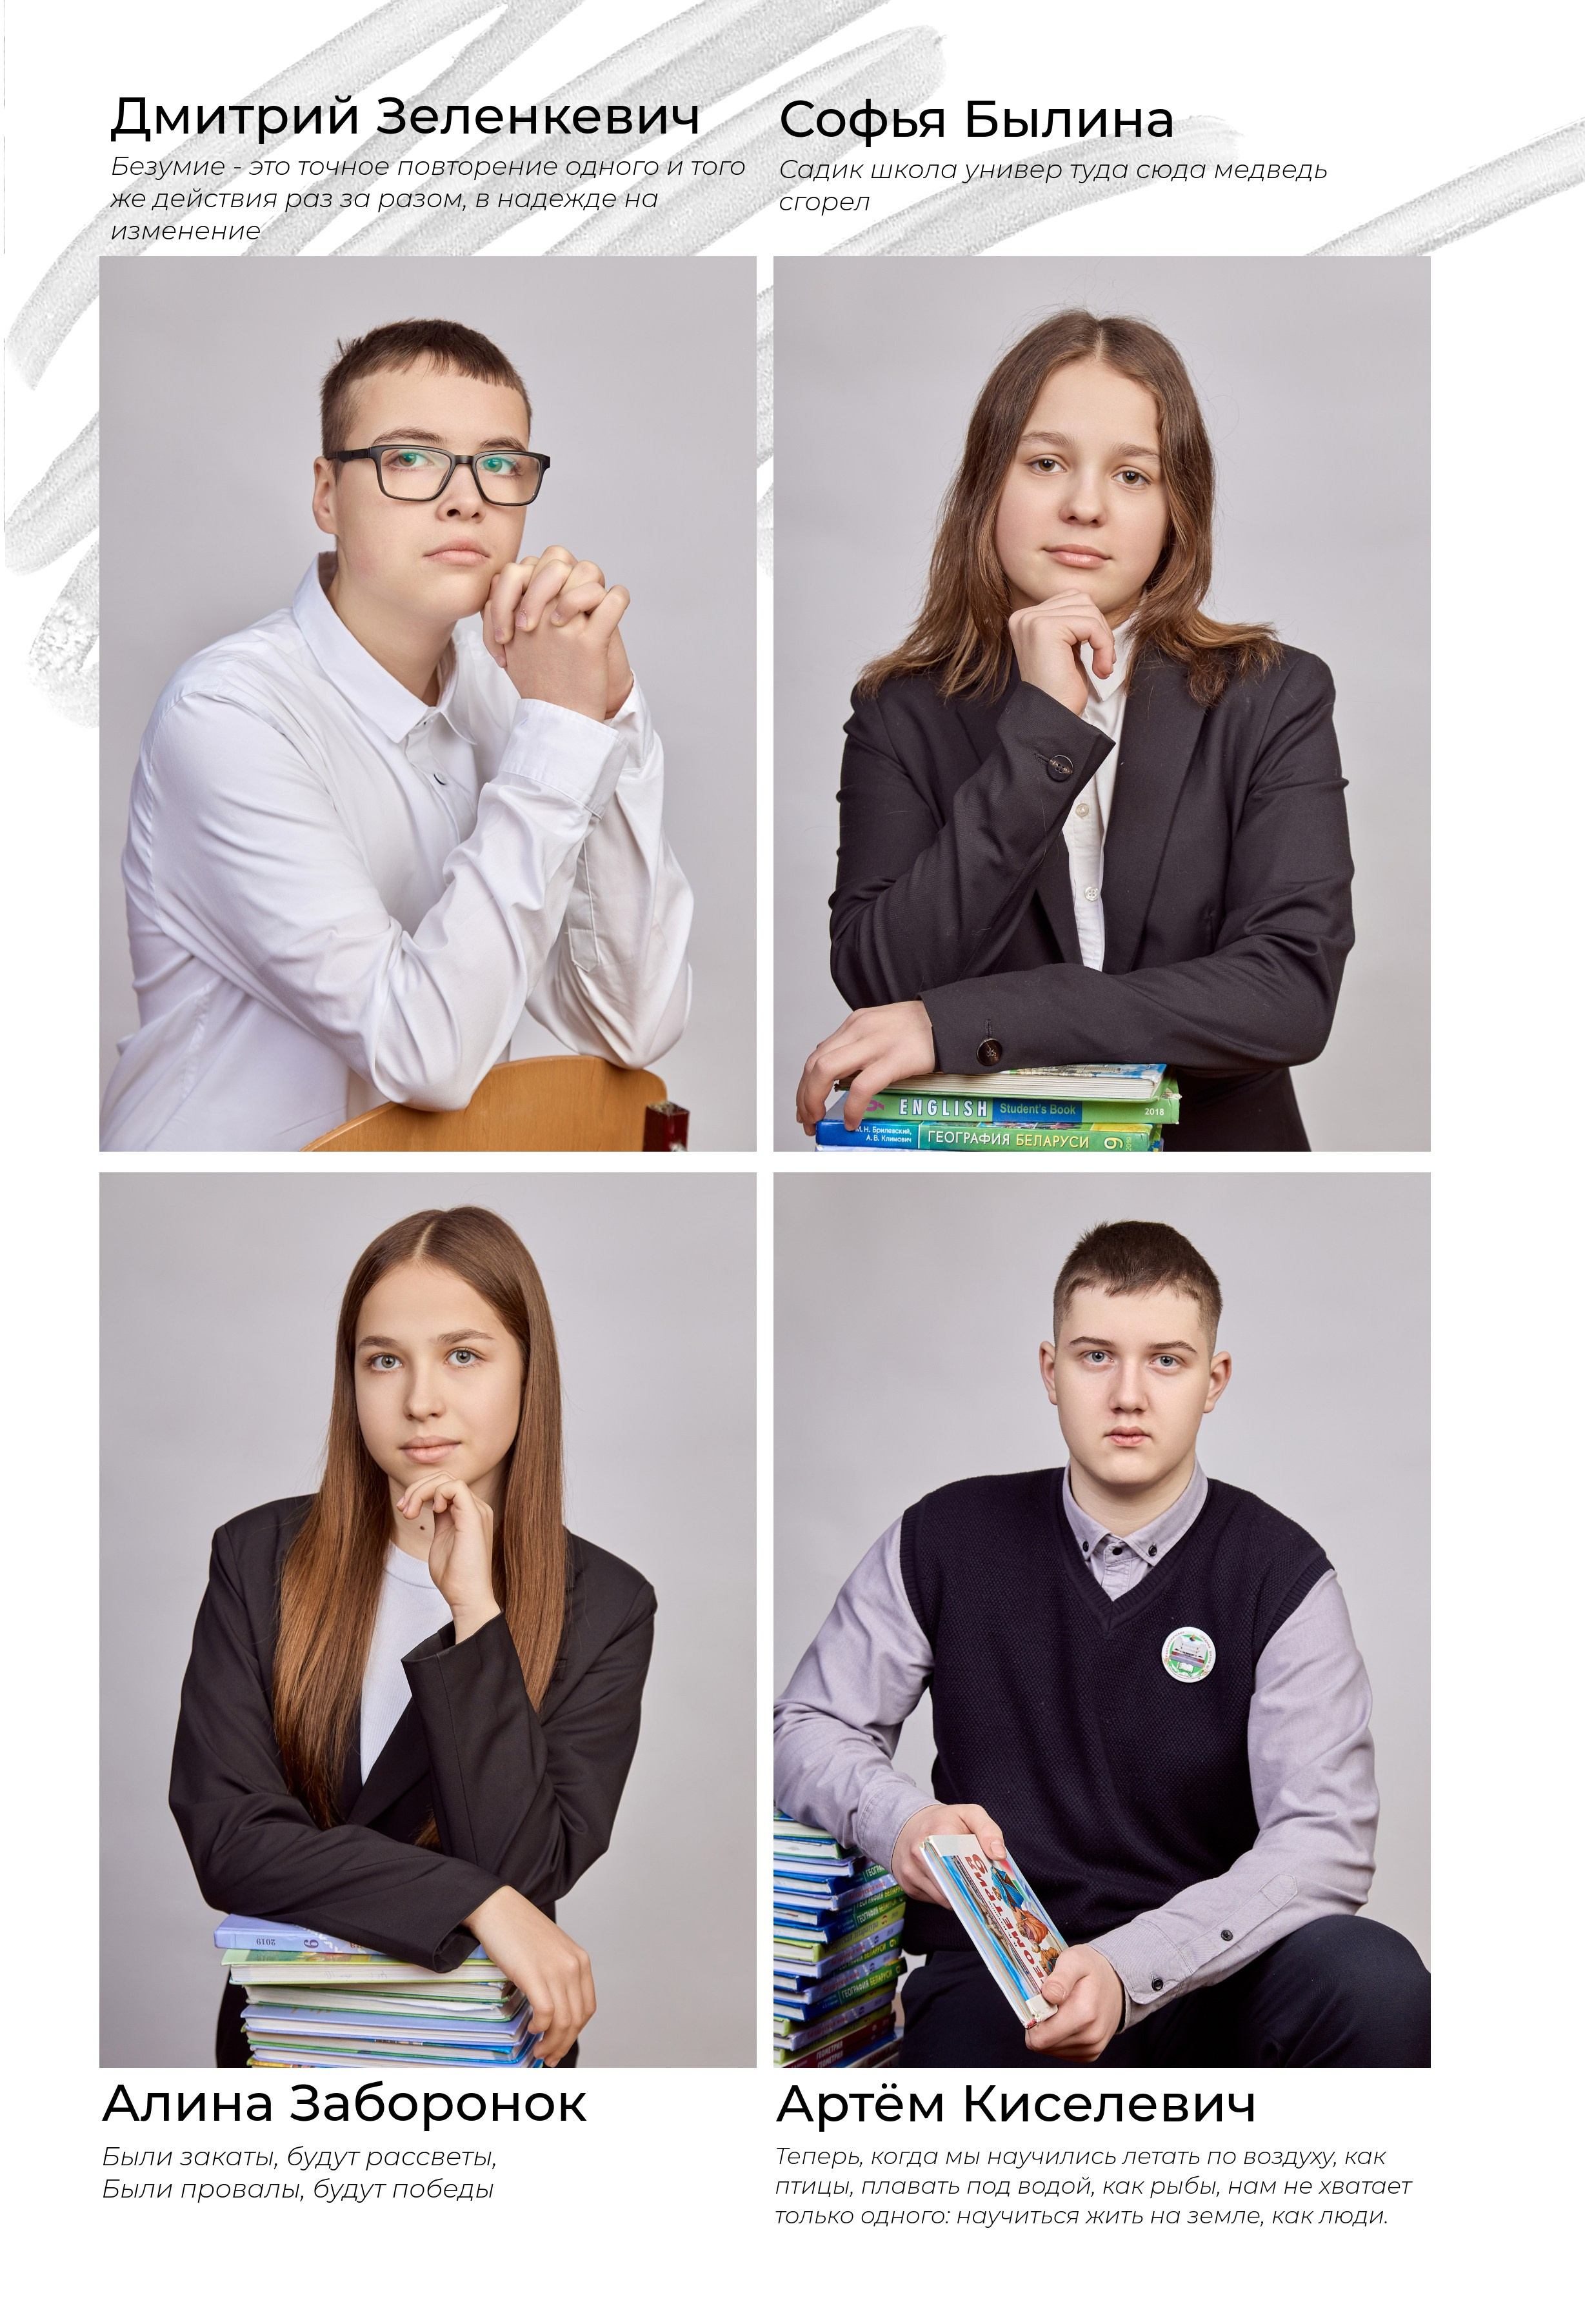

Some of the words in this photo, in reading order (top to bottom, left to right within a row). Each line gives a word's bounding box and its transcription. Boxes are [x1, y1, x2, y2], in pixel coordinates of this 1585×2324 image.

[899, 1099, 988, 1117] ENGLISH
[1050, 1104, 1076, 1115] Book
[872, 1127, 912, 1136] Брилевский,
[928, 1131, 1010, 1145] ГЕОГРАФИЯ
[1016, 1134, 1090, 1148] БЕЛАРУСИ
[1104, 1137, 1124, 1150] 9
[972, 1854, 988, 1874] 9
[841, 1979, 870, 1999] ГЕОГРАФИЯ
[869, 1969, 893, 1987] БЕЛАРУСИ
[816, 2040, 844, 2060] ГЕОМЕТРИЯ
